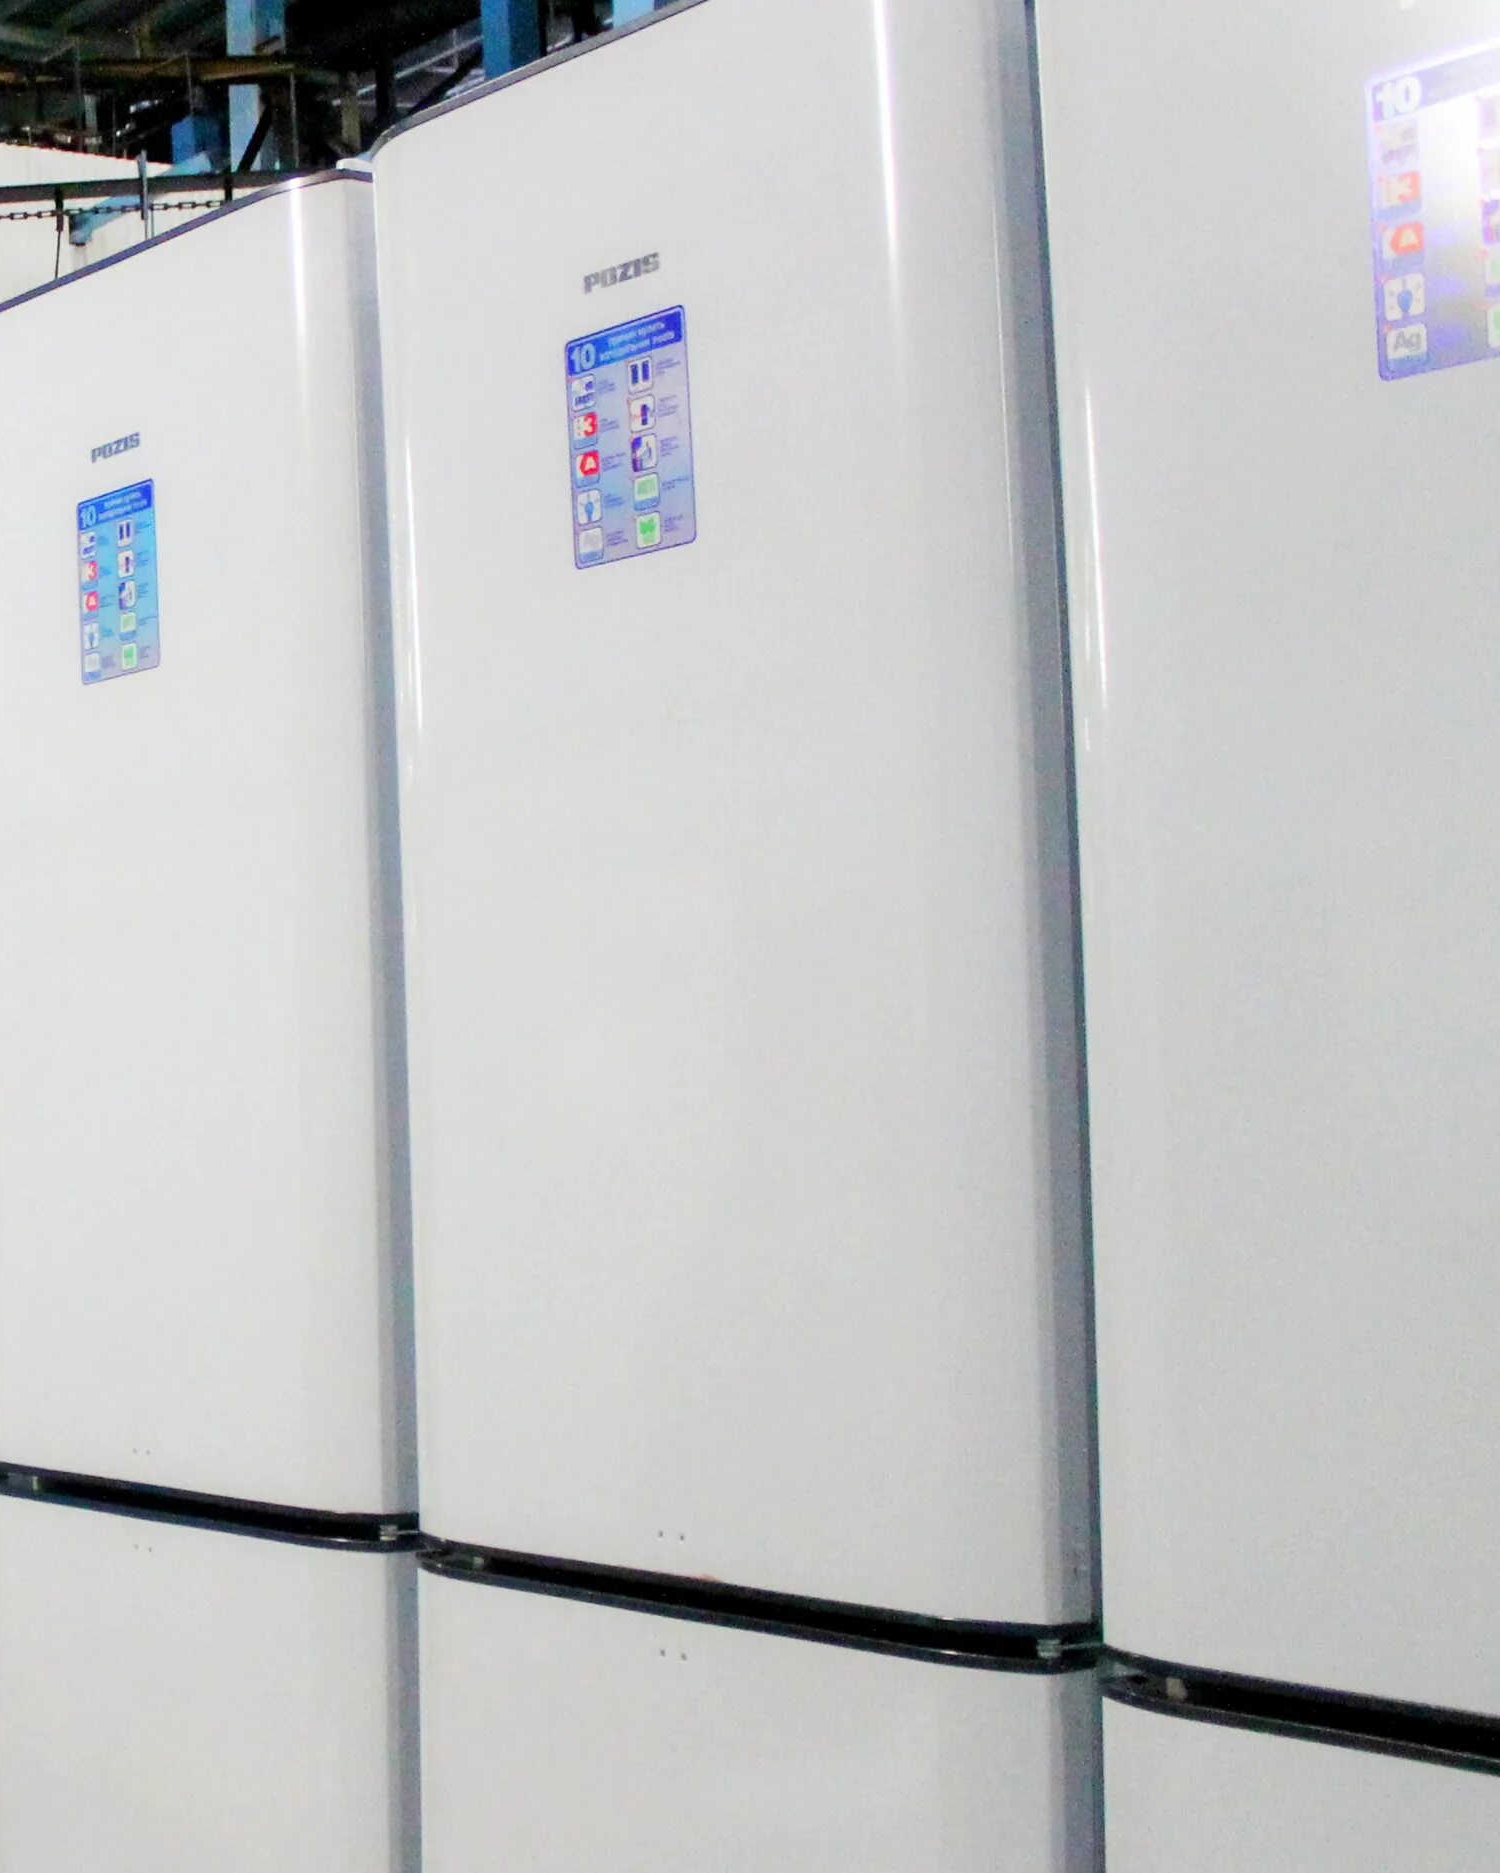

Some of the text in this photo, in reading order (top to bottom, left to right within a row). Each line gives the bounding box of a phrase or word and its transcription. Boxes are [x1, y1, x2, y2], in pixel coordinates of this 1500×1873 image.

[1376, 76, 1421, 120] 10
[583, 252, 660, 294] POZIS
[1394, 330, 1421, 352] Ag
[570, 342, 596, 374] 10
[91, 431, 141, 464] POZIS
